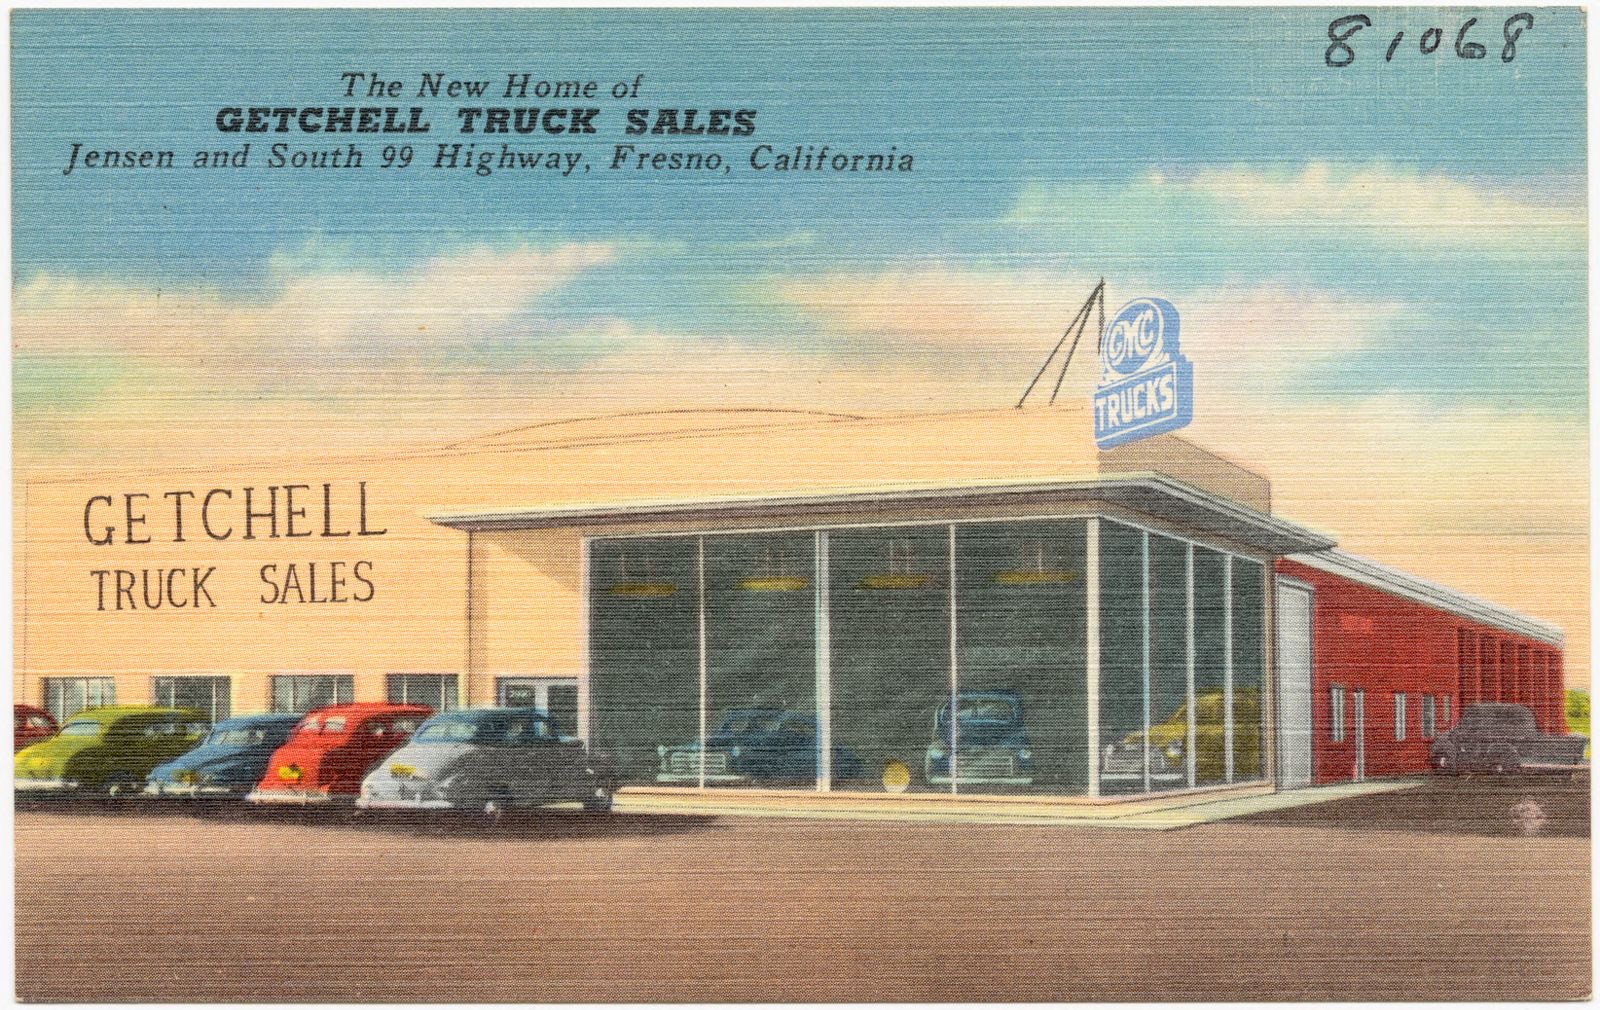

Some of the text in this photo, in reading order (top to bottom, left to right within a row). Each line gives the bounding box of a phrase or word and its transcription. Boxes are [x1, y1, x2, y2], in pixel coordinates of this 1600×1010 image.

[1325, 12, 1534, 67] 81068
[1107, 308, 1156, 367] GMC
[1095, 373, 1173, 432] TRUCKS
[83, 481, 388, 546] GETCHELL
[90, 560, 375, 611] TRUCK SALES
